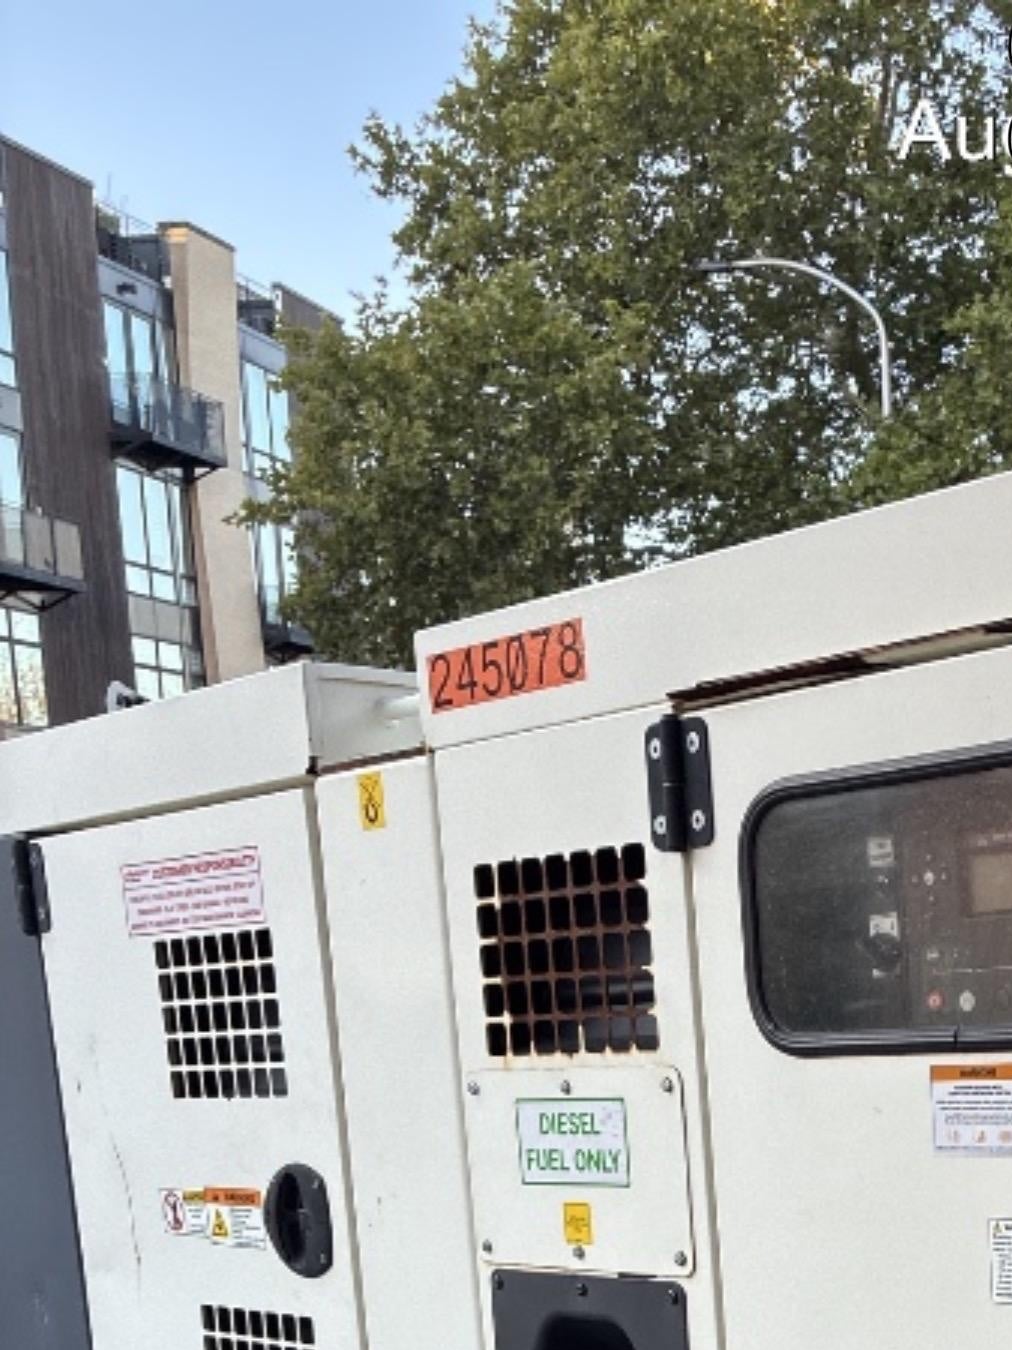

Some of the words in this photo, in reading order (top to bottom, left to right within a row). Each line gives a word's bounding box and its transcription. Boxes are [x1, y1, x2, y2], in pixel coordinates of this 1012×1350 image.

[430, 620, 581, 709] 245078
[538, 1112, 602, 1136] DIESEL
[526, 1148, 571, 1172] FUEL
[574, 1148, 622, 1174] ONLY
